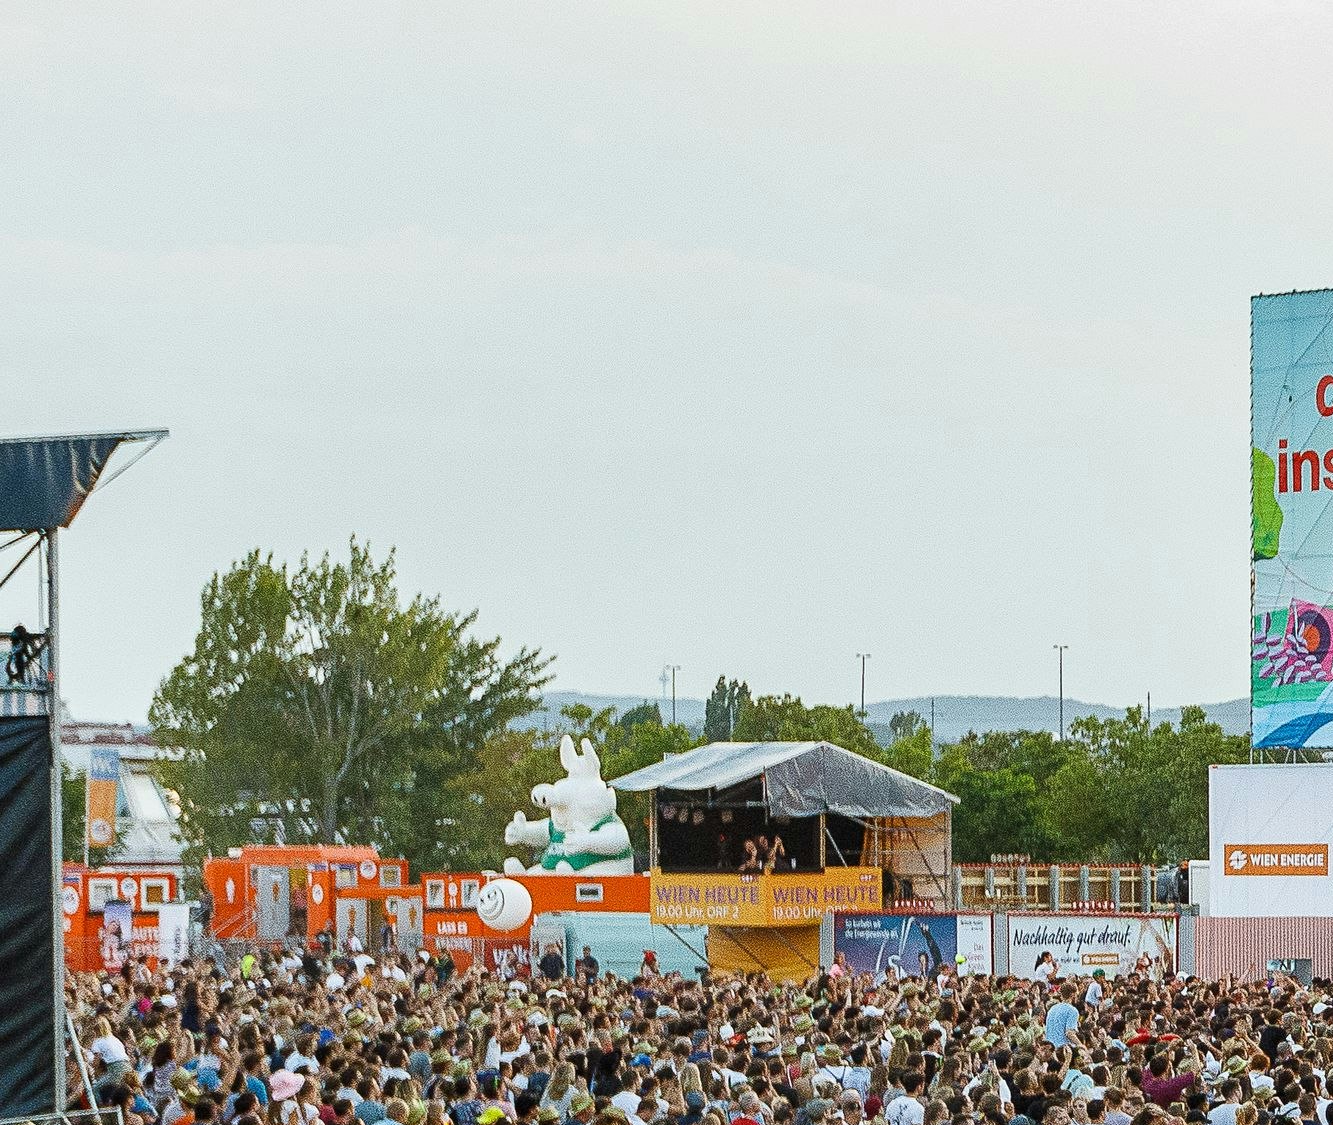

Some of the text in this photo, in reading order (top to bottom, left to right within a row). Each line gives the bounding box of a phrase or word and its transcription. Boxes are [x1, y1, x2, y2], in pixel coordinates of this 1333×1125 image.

[1250, 853, 1324, 867] WIEN ENERGIE
[656, 884, 759, 904] WIEN HEUTE
[773, 885, 879, 903] WIEN HEUTE
[1014, 925, 1074, 953] Nachhaltig
[1077, 928, 1095, 953] gut
